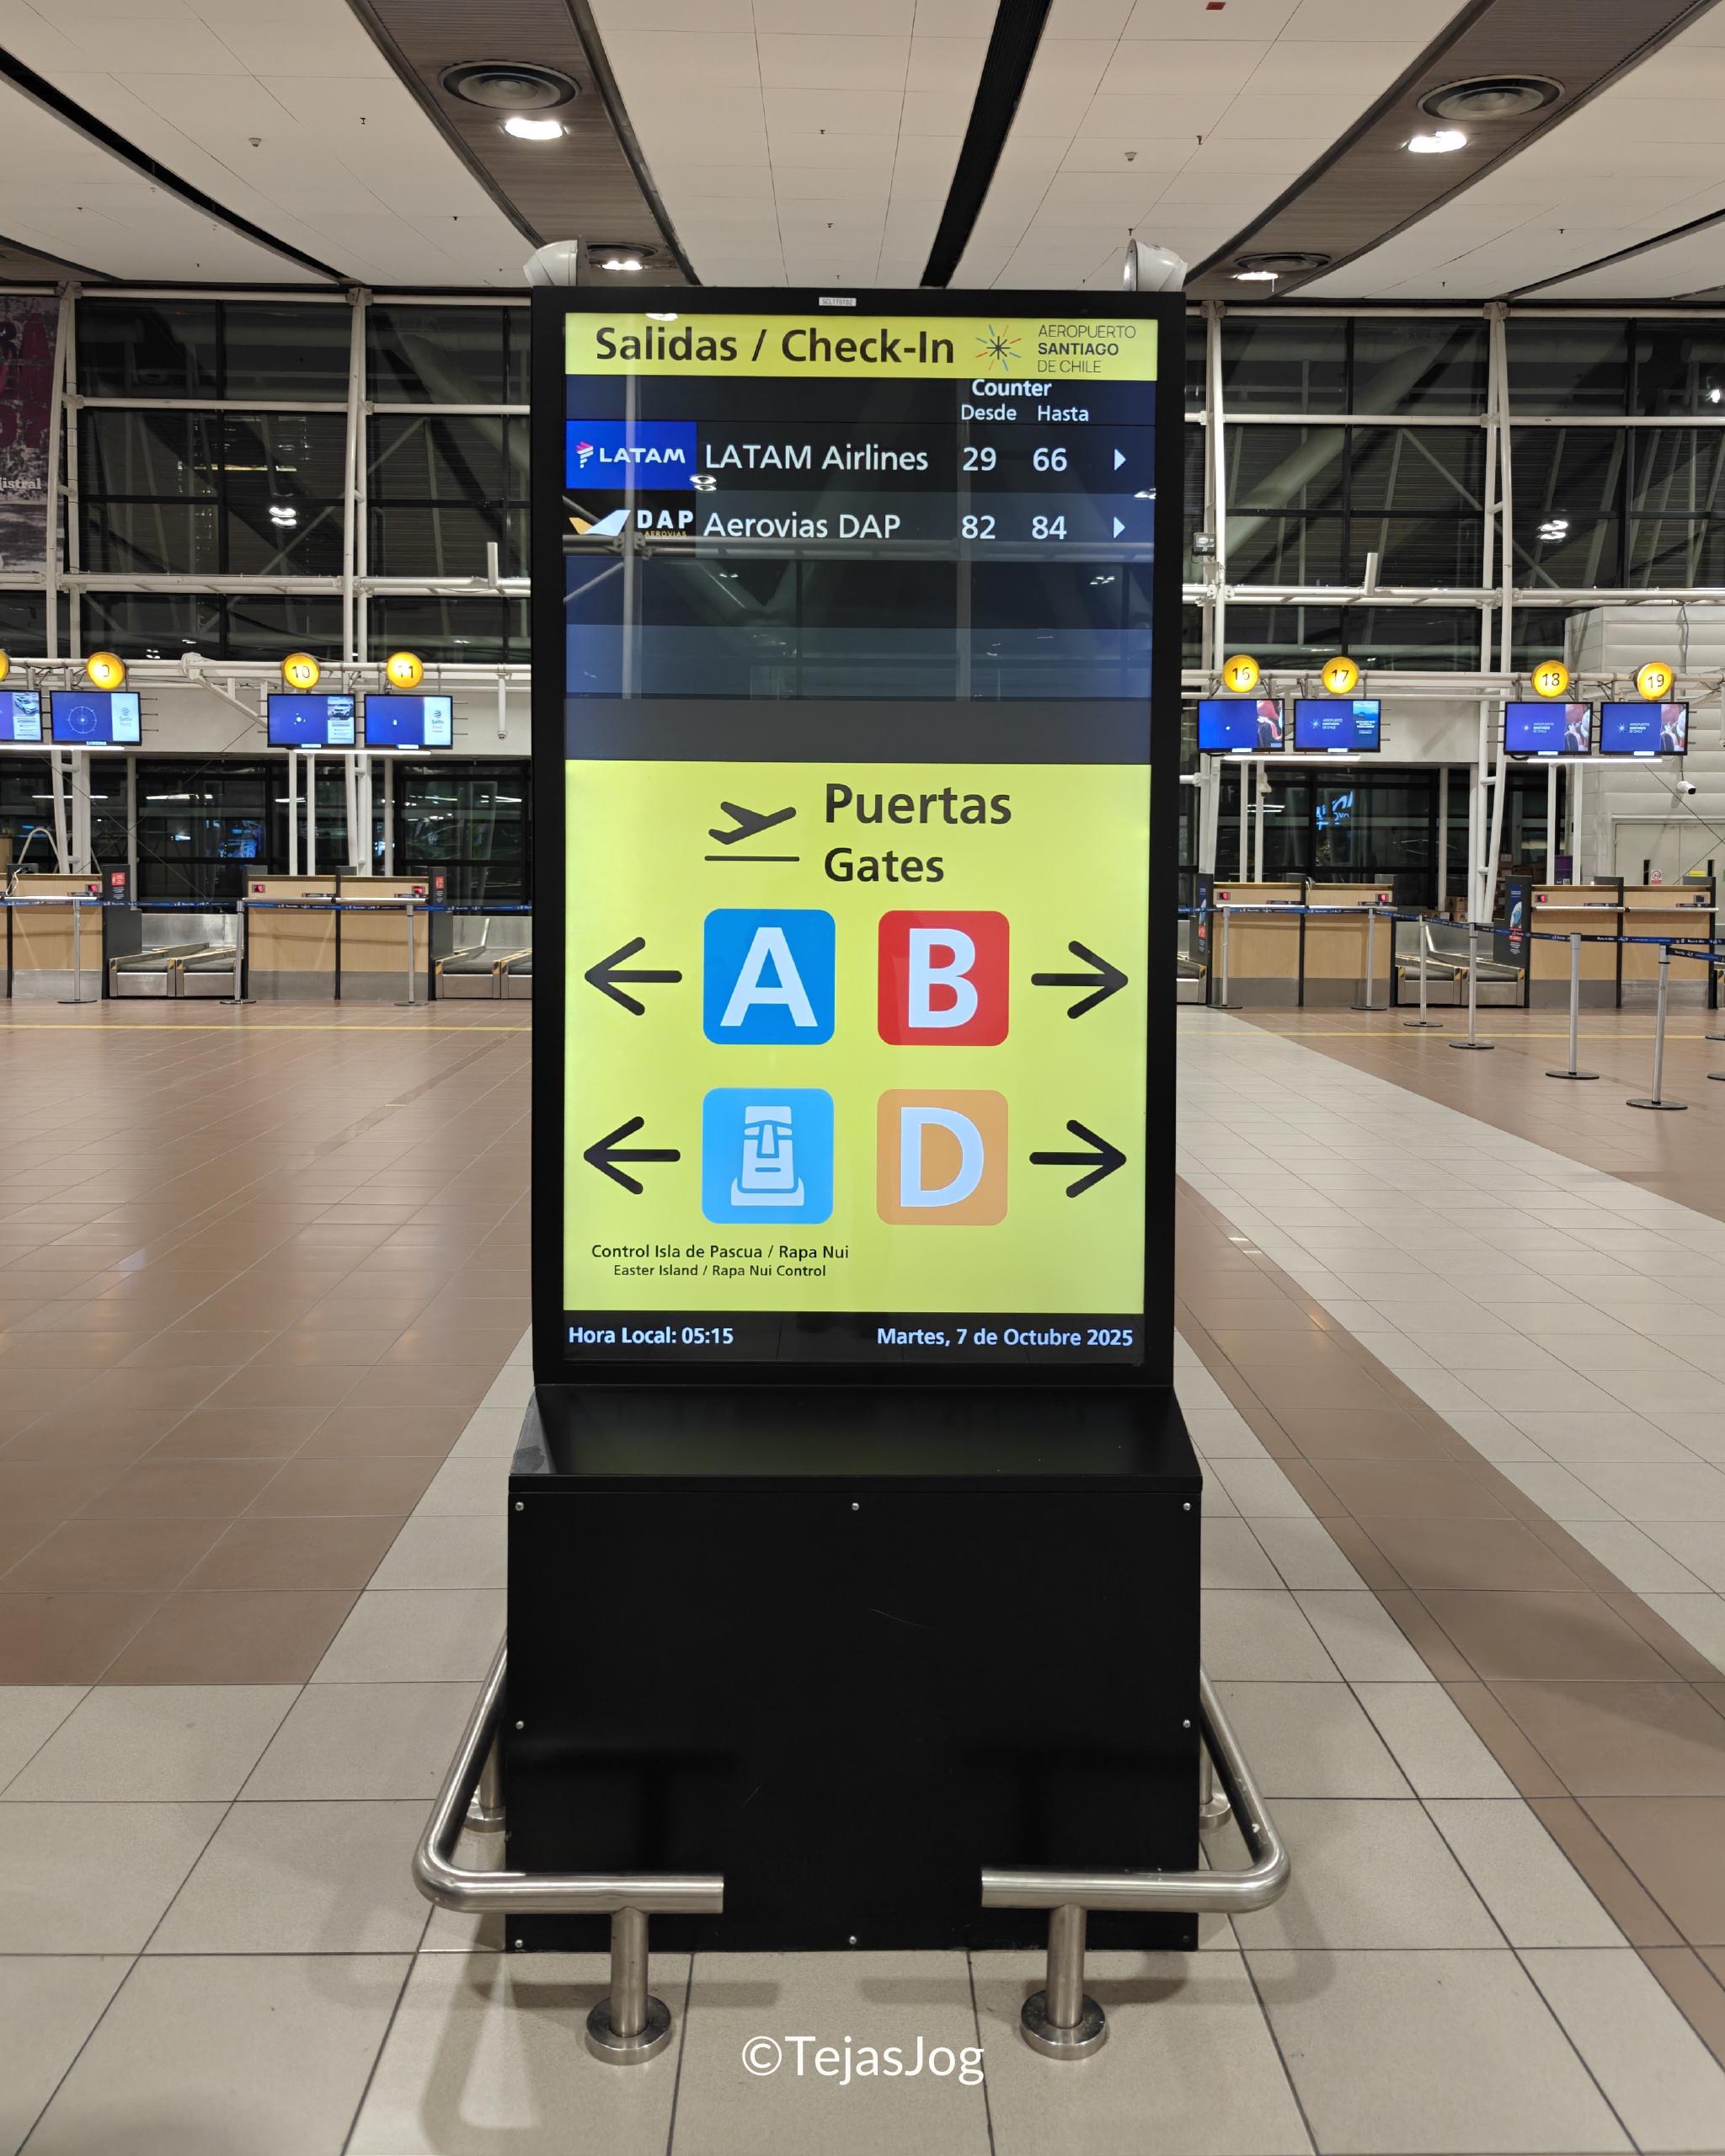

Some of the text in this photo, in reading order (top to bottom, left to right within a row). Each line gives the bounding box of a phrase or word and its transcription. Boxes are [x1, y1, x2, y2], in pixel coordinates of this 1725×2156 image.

[1038, 324, 1136, 339] AEROPUERTO
[596, 326, 953, 364] Salidas / Check-In
[1038, 342, 1119, 356] SANTIAGO
[1037, 360, 1102, 373] DE CHILE
[971, 378, 1053, 397] Counter
[961, 403, 1089, 422] Desde Hasta
[599, 447, 686, 463] LATAM
[706, 443, 1067, 472] LATAM Airlines 29 66
[0, 477, 41, 491] istral
[637, 510, 694, 529] DAP
[702, 511, 1067, 540] Aerovias DAP 82 84
[291, 665, 311, 679] 10
[1331, 669, 1349, 683] 17
[1542, 672, 1560, 686] 18
[1648, 674, 1664, 689] 19
[825, 782, 1012, 825] Puertas
[824, 847, 944, 883] Gates
[720, 926, 979, 1028] A B
[899, 1107, 985, 1207] D
[591, 1244, 849, 1262] Control Isla de Pascua / Rapa Nui
[613, 1263, 826, 1279] Easter Island / Rapa Nui Control
[569, 1326, 1133, 1348] Hora Local: 05:15 Martes, 7 de Octubre 2025
